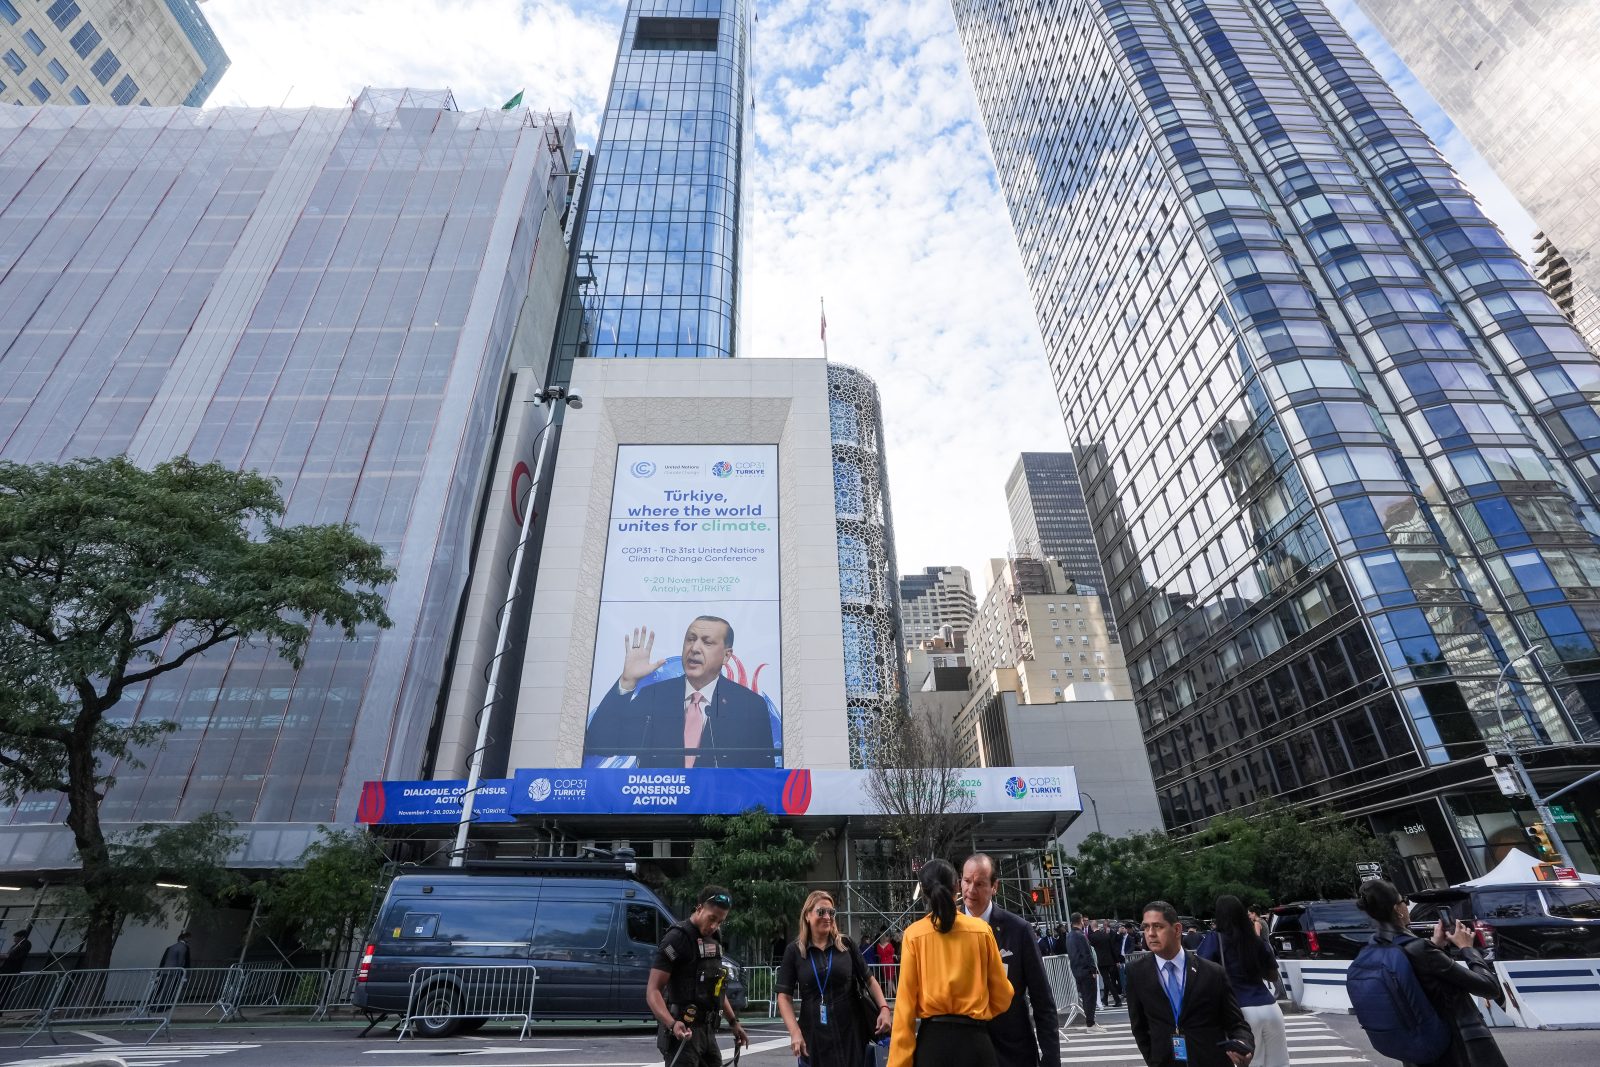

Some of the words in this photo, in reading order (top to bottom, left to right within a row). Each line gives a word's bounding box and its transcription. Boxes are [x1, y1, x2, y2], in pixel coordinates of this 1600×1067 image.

[664, 490, 728, 504] Türkiye,
[628, 505, 679, 516] where
[684, 505, 710, 516] the
[715, 505, 762, 516] world
[618, 520, 669, 532] unites
[674, 520, 698, 531] for
[702, 520, 771, 531] climate.
[667, 555, 702, 563] Change
[651, 585, 689, 593] Antalya,
[628, 775, 686, 784] DIALOGUE
[1029, 777, 1061, 786] COP31
[554, 780, 587, 789] COP31
[452, 787, 507, 795] COENSUS.
[622, 786, 690, 795] CONSENSUS
[633, 796, 677, 805] ACTION
